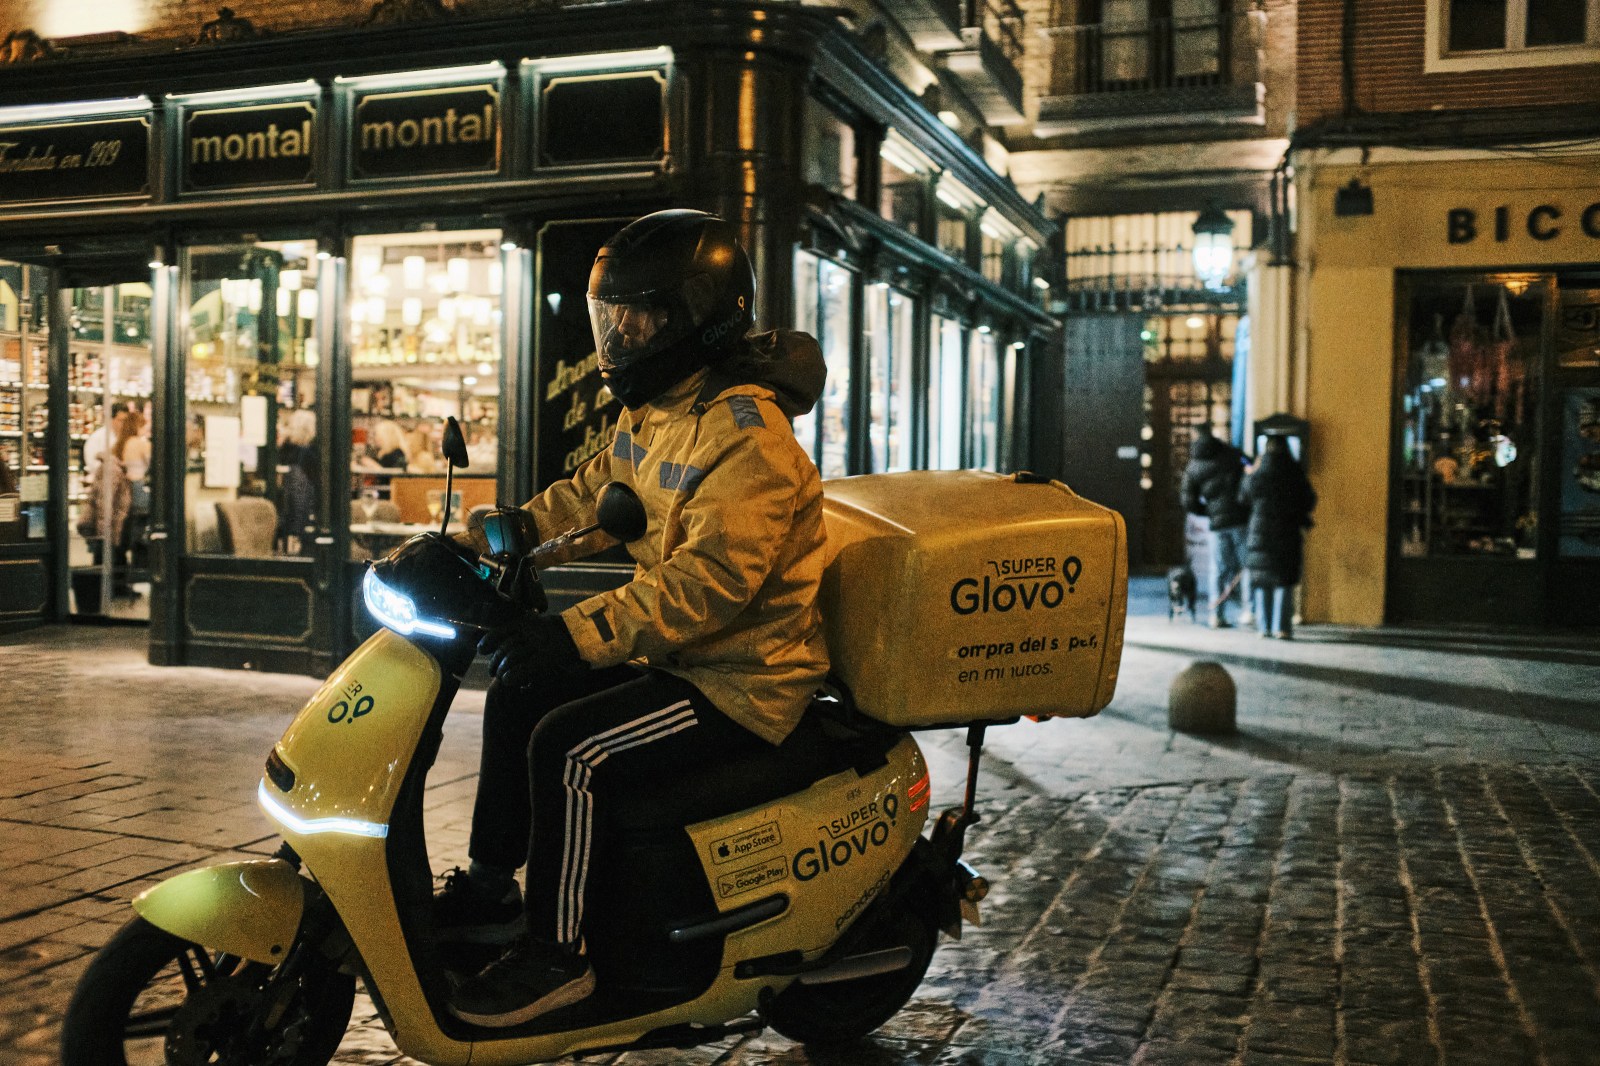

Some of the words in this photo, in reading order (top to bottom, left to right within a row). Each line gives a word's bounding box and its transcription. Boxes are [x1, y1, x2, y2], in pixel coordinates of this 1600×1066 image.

[361, 104, 493, 150] montal
[191, 120, 311, 163] montal
[1001, 557, 1056, 574] SUPER
[950, 575, 1064, 615] Glovo
[1019, 636, 1047, 653] del
[958, 669, 979, 683] en
[831, 802, 879, 834] SUPER
[734, 843, 753, 854] App
[752, 834, 775, 848] Store
[792, 821, 889, 882] Glovo
[735, 873, 766, 889] Google
[766, 867, 785, 879] Play
